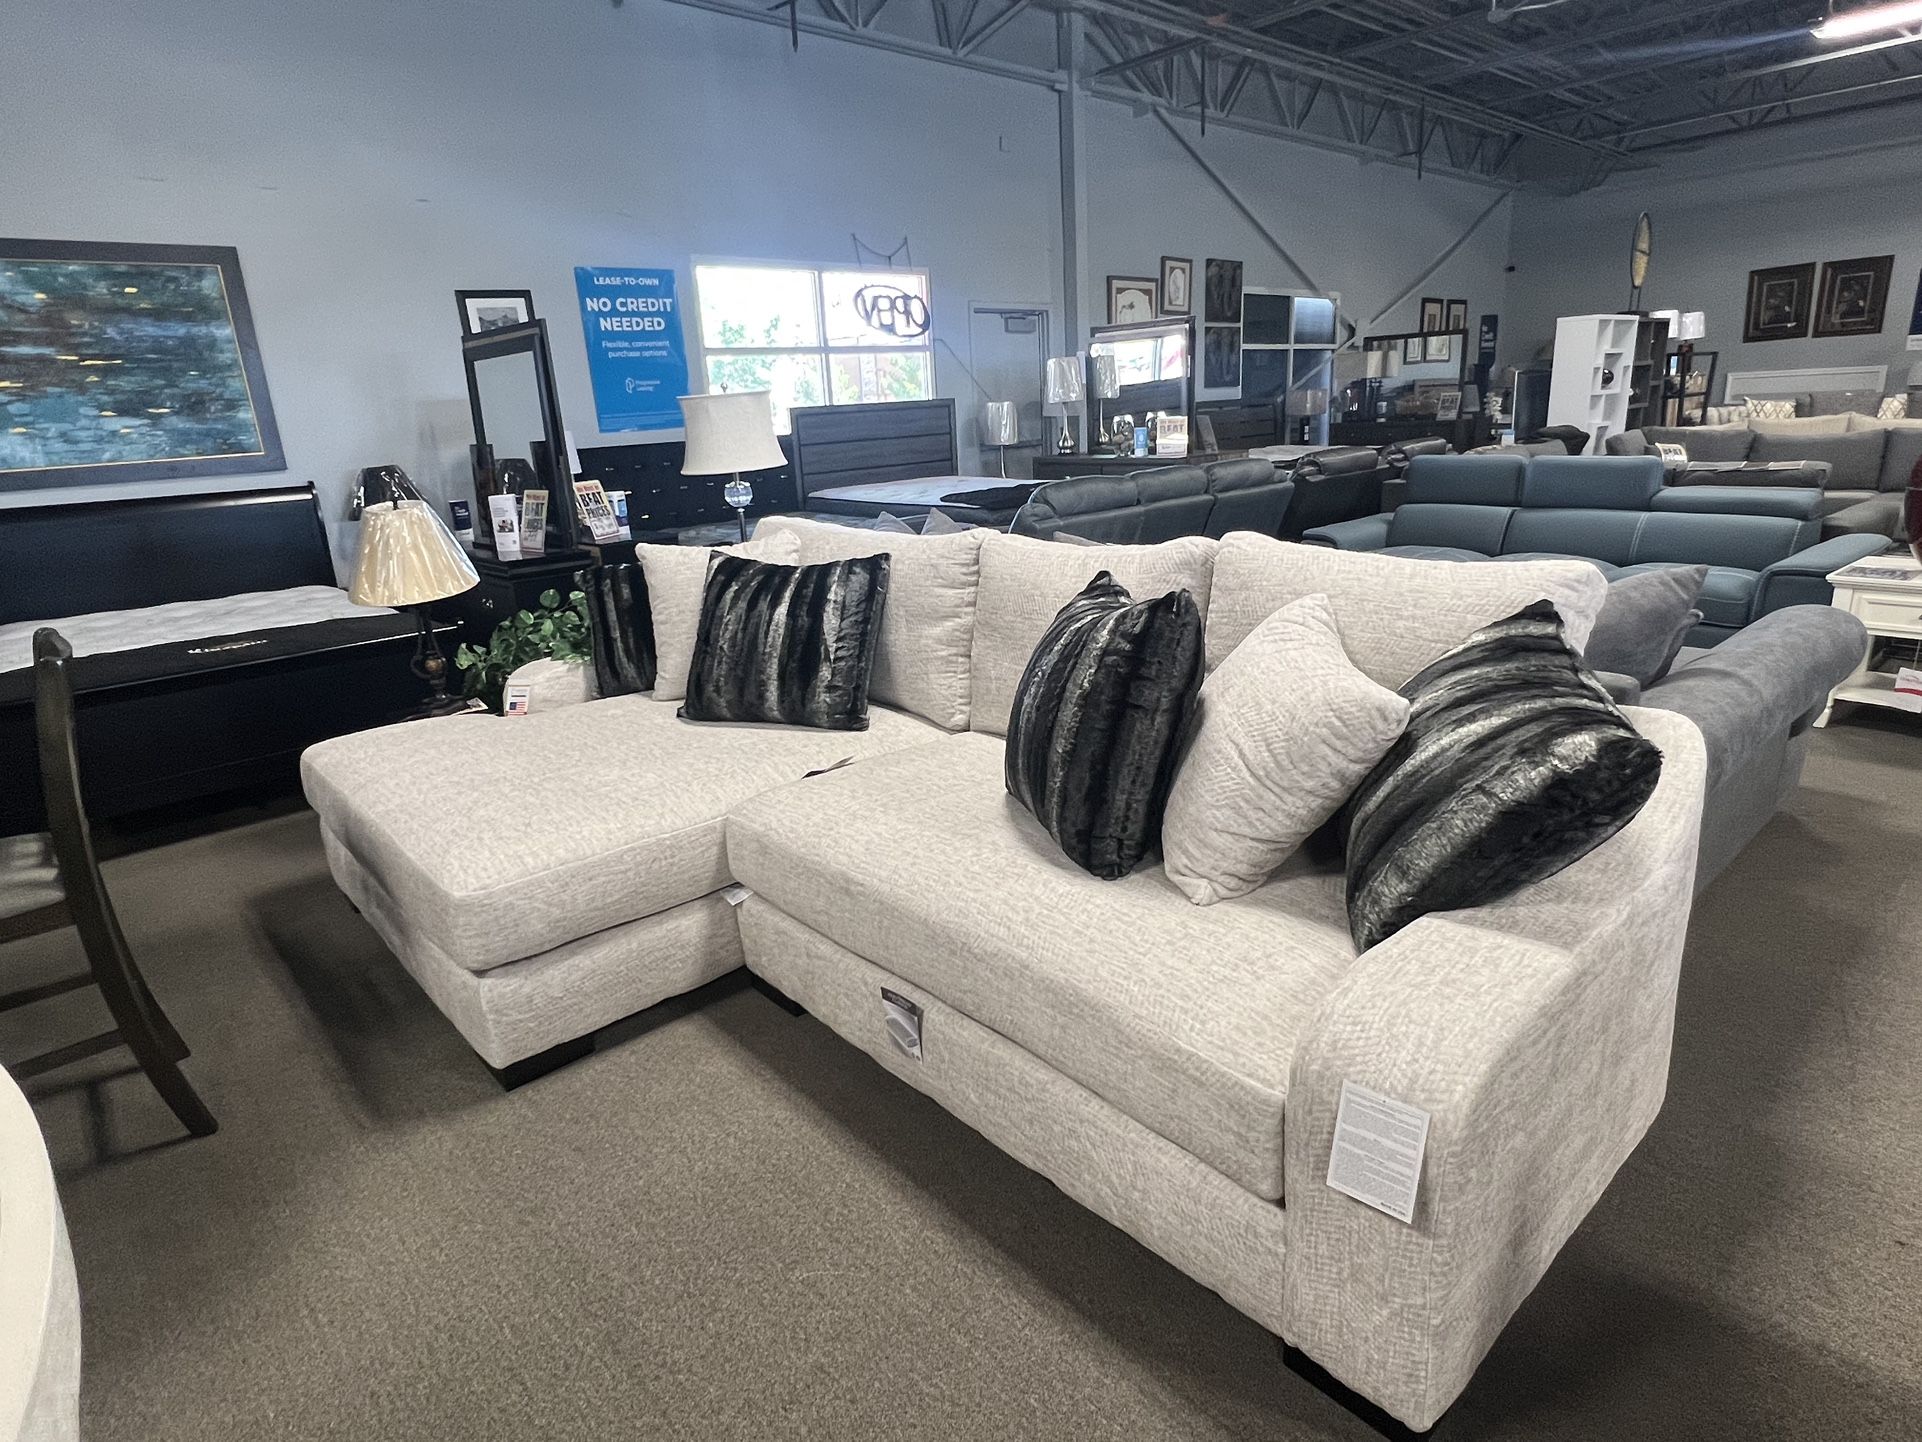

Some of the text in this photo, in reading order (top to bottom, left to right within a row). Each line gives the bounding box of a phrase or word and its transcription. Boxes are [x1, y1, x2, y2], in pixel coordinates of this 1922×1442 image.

[593, 276, 659, 286] LEASE-TO-OWN
[585, 297, 673, 312] NO CREDIT
[599, 317, 666, 331] NEEDED
[602, 340, 670, 348] Flexible, convenient
[608, 350, 668, 359] purchase options
[579, 491, 605, 507] BEAT
